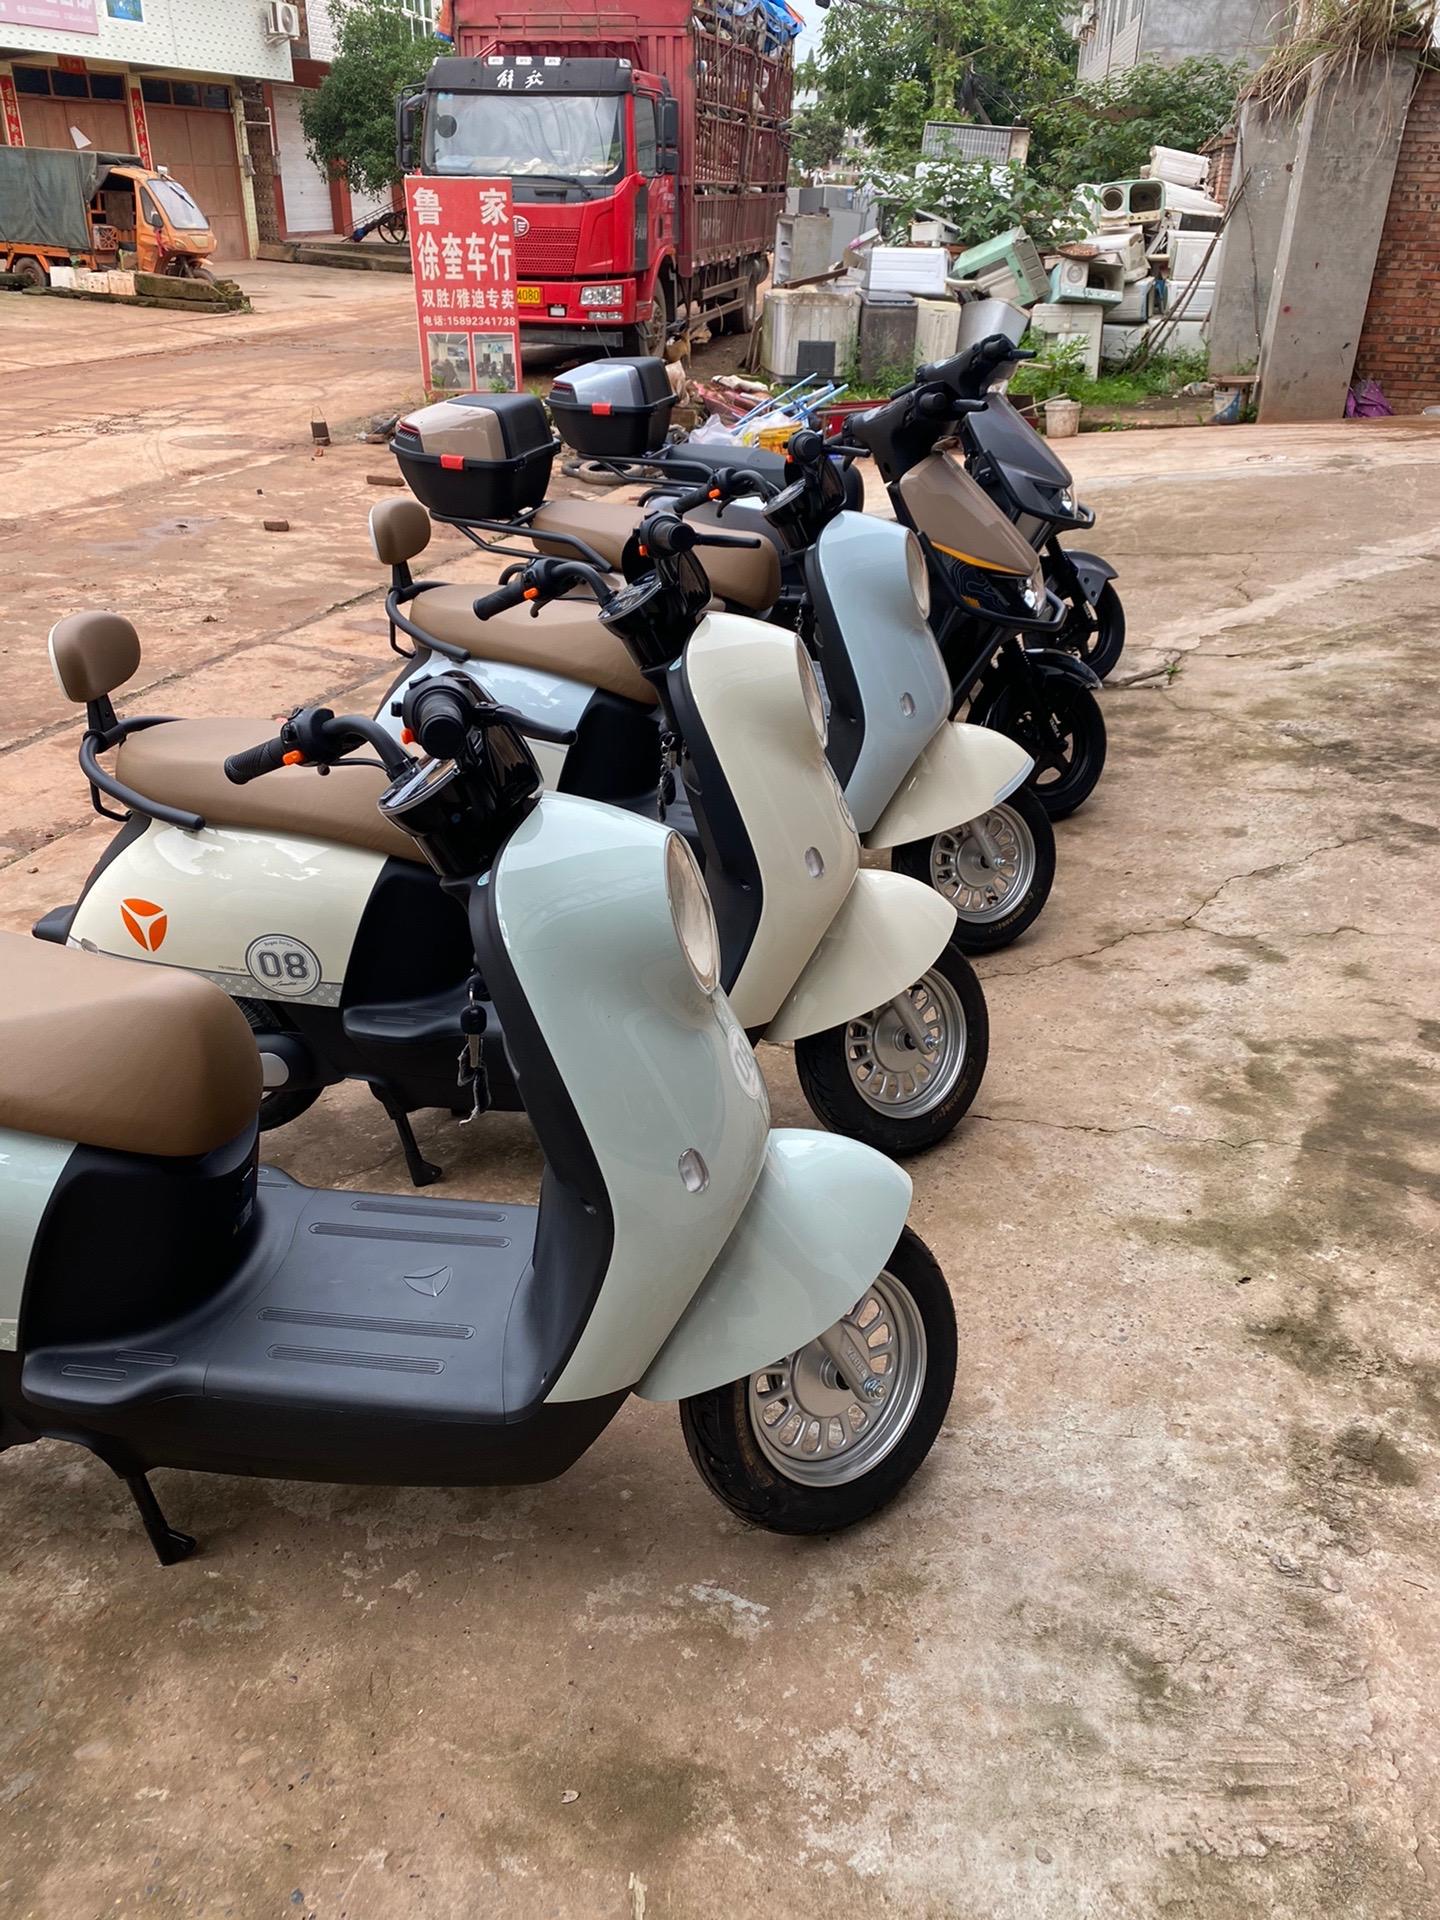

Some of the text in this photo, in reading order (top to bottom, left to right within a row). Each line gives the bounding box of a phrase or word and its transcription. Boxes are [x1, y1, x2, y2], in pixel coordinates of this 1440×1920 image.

[416, 231, 512, 281] 徐奎车行
[421, 288, 515, 310] 双胜/雅迪专卖
[256, 950, 310, 980] 08
